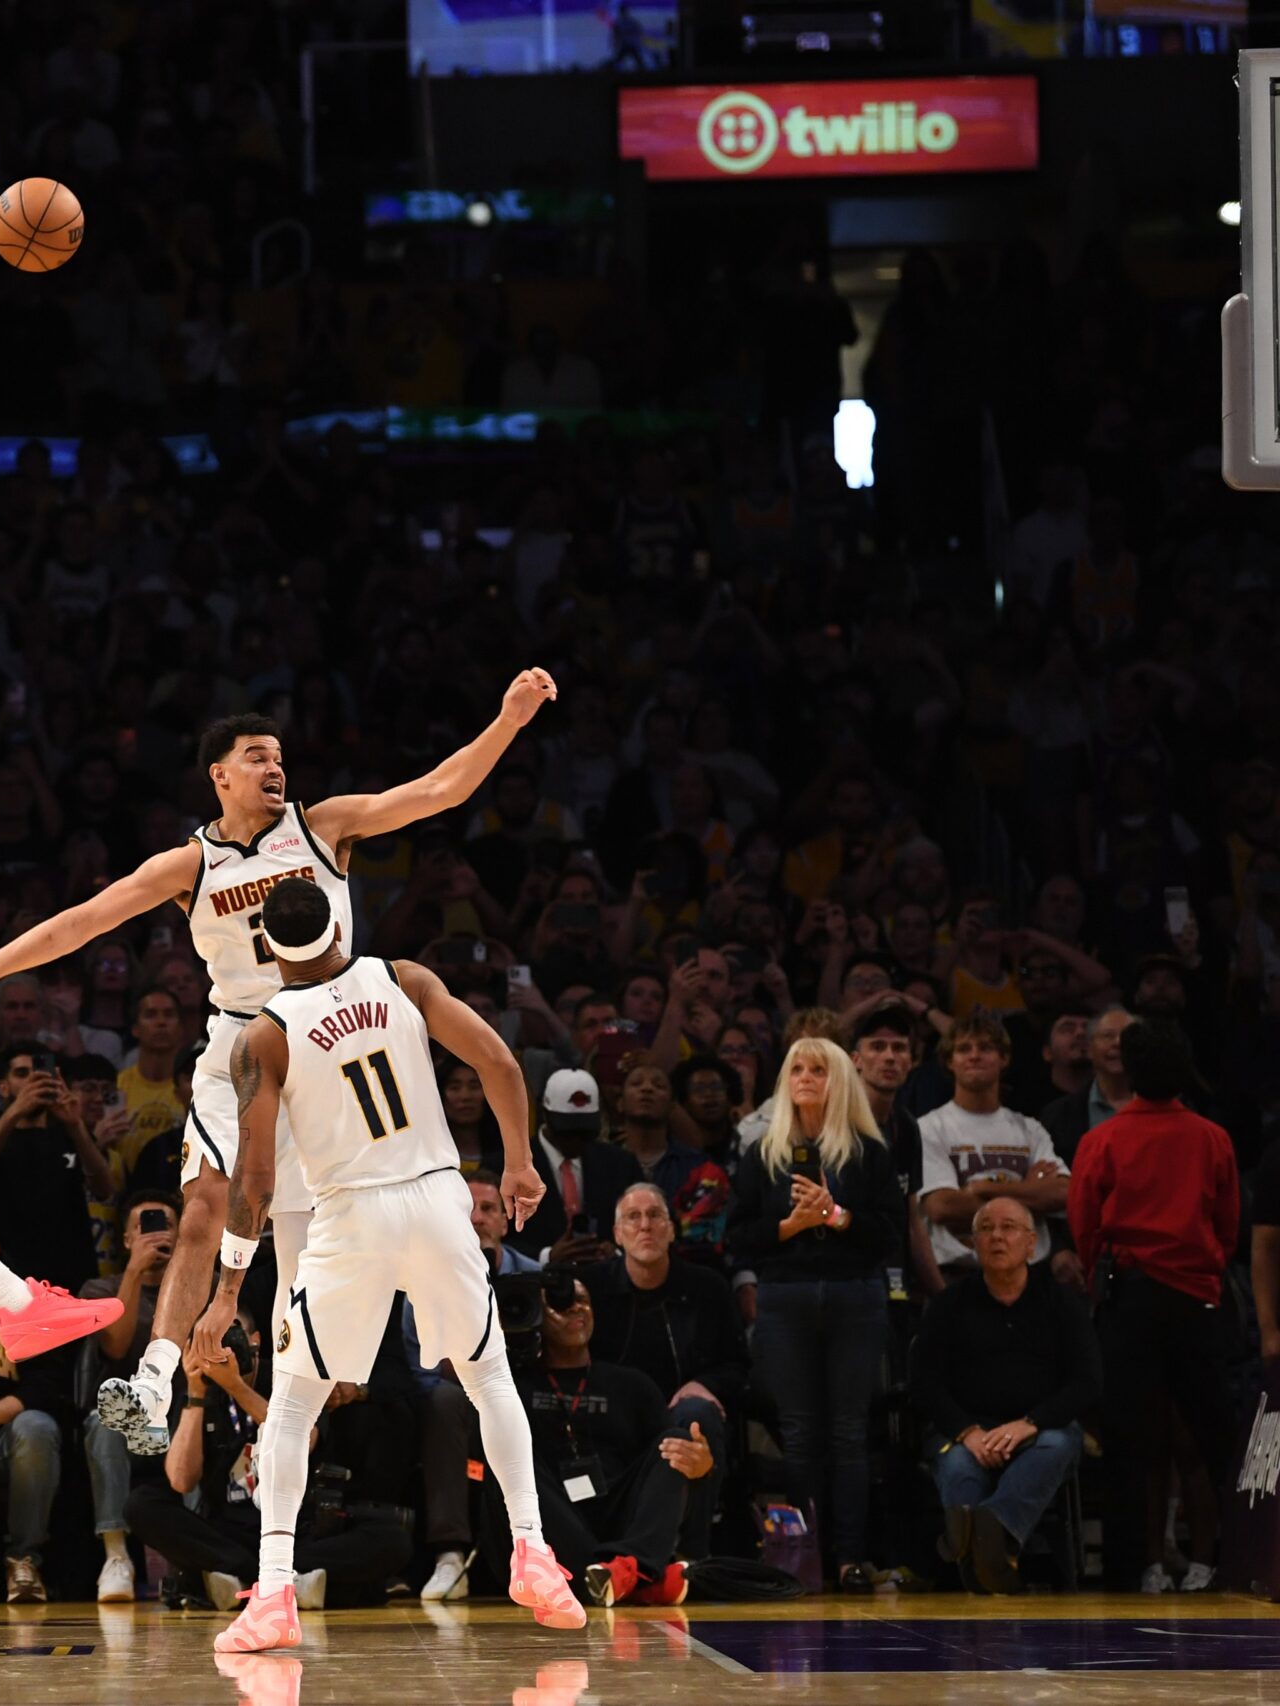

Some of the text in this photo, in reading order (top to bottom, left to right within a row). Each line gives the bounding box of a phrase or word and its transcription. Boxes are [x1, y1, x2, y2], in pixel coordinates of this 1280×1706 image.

[784, 102, 959, 157] twilio
[270, 837, 300, 851] ibotta
[307, 1001, 388, 1052] BROWN
[339, 1047, 411, 1142] 11
